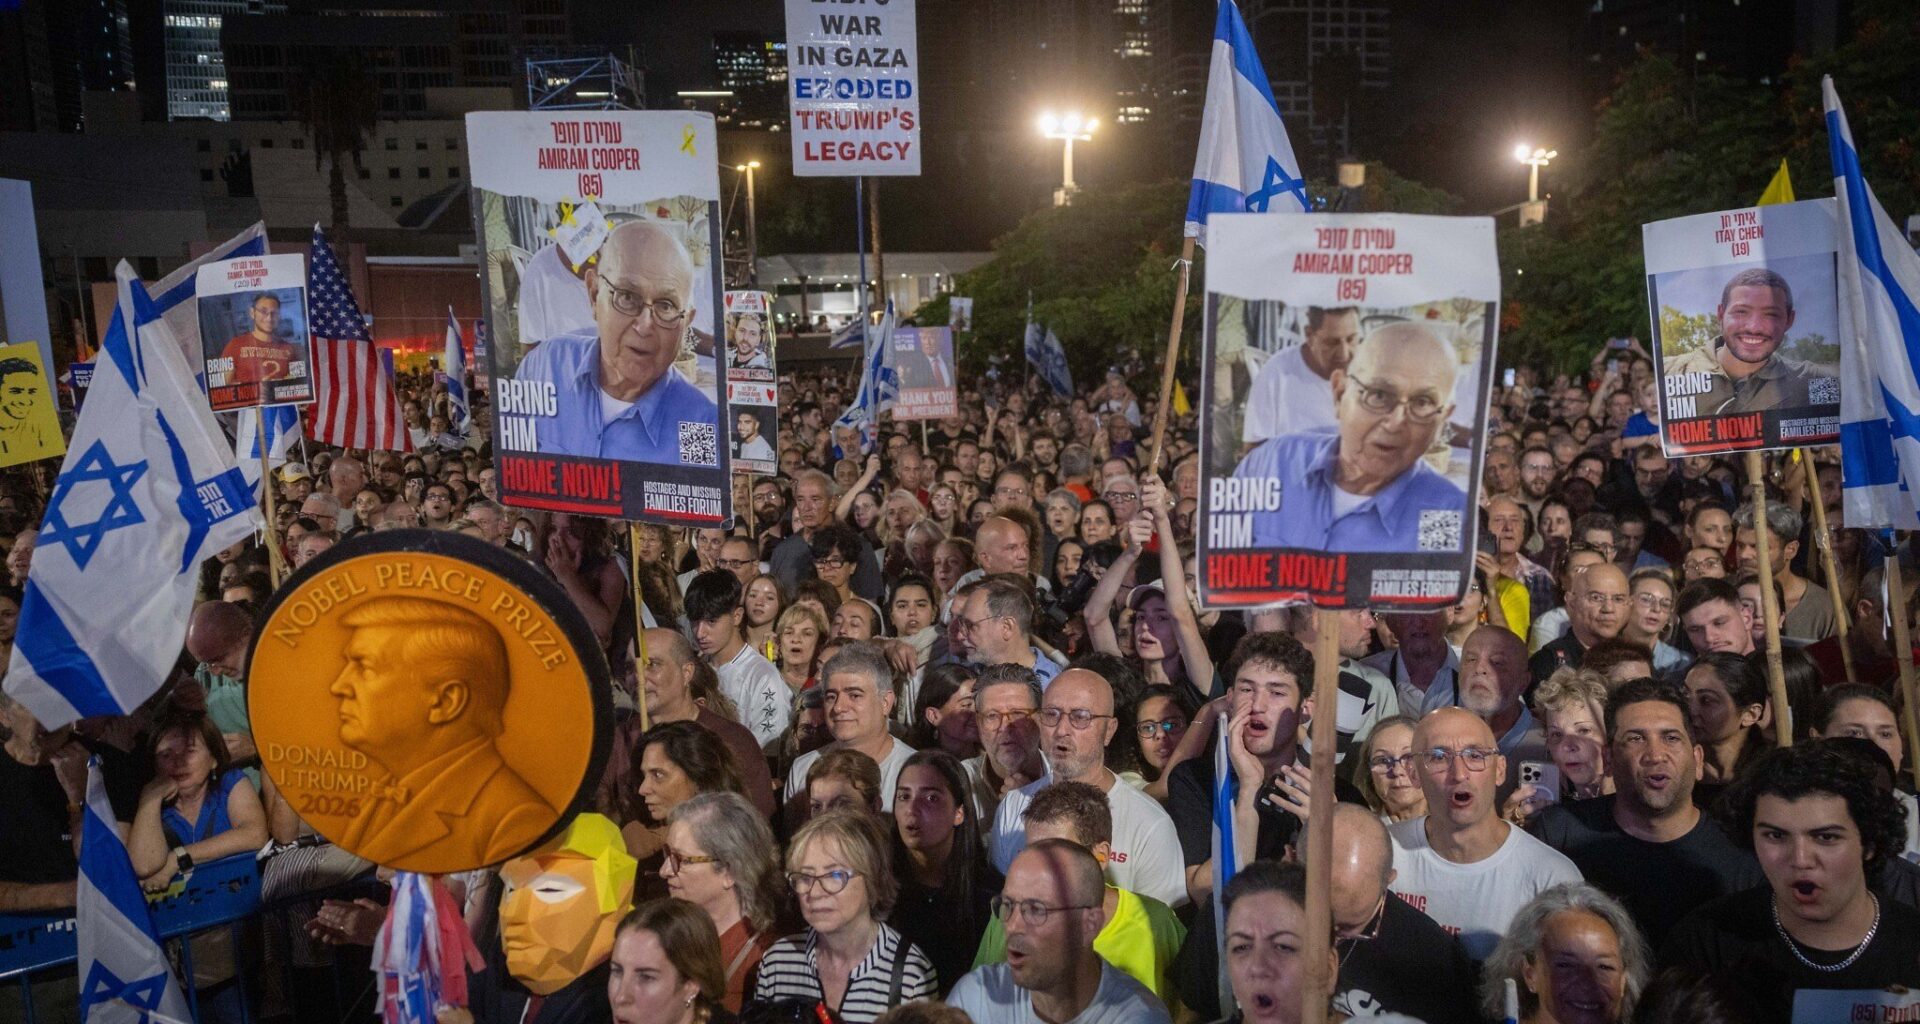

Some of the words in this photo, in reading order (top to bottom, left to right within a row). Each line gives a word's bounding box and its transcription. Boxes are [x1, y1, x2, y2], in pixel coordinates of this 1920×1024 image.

[820, 14, 882, 36] WAR
[797, 46, 825, 66] IN
[834, 47, 909, 68] GAZA
[795, 77, 912, 100] ERODED
[796, 107, 915, 131] TRUMP'S
[551, 122, 579, 146] קופר
[584, 121, 622, 144] עמירם
[538, 148, 589, 170] AMIRAM
[592, 148, 640, 171] COOPER
[804, 141, 911, 161] LEGACY
[578, 173, 603, 197] (85)
[1721, 215, 1731, 229] חן
[1734, 211, 1757, 226] איתי
[1314, 228, 1348, 251] קופר
[1352, 228, 1395, 250] עמירם
[1715, 229, 1736, 244] ITAY
[1739, 226, 1764, 240] CHEN
[1732, 242, 1750, 257] (19)
[1293, 254, 1354, 274] AMIRAM
[1358, 254, 1413, 275] COOPER
[1337, 278, 1366, 302] (85)
[207, 357, 234, 373] BRING
[208, 372, 226, 388] HIM
[1665, 372, 1712, 397] BRING
[211, 387, 233, 404] HOME
[497, 378, 558, 417] BRING
[900, 391, 929, 405] HANK
[931, 391, 953, 404] YOU
[912, 405, 954, 416] PRESIDENT
[1667, 396, 1697, 420] HIM
[501, 415, 538, 453] HIM
[1668, 420, 1712, 444] HOME
[1716, 412, 1763, 440] NOW!
[1780, 425, 1815, 438] FAMILIES
[502, 456, 557, 495] HOME
[562, 461, 621, 501] NOW!
[643, 480, 677, 497] HOSTAGES
[677, 484, 691, 498] AND
[691, 486, 722, 500] MISSING
[644, 493, 687, 513] FAMILIES
[688, 497, 722, 517] FORUM
[1209, 476, 1282, 513] BRING
[1208, 513, 1253, 549] HIM
[1207, 554, 1272, 589] HOME
[1278, 554, 1347, 593] NOW!
[1371, 580, 1420, 597] FAMILIES
[1421, 582, 1459, 598] FORUM
[273, 571, 367, 648] NOBEL
[375, 562, 485, 602] PEACE
[489, 591, 568, 671] PRIZE
[268, 743, 367, 770] DONALD
[299, 793, 361, 818] 2026
